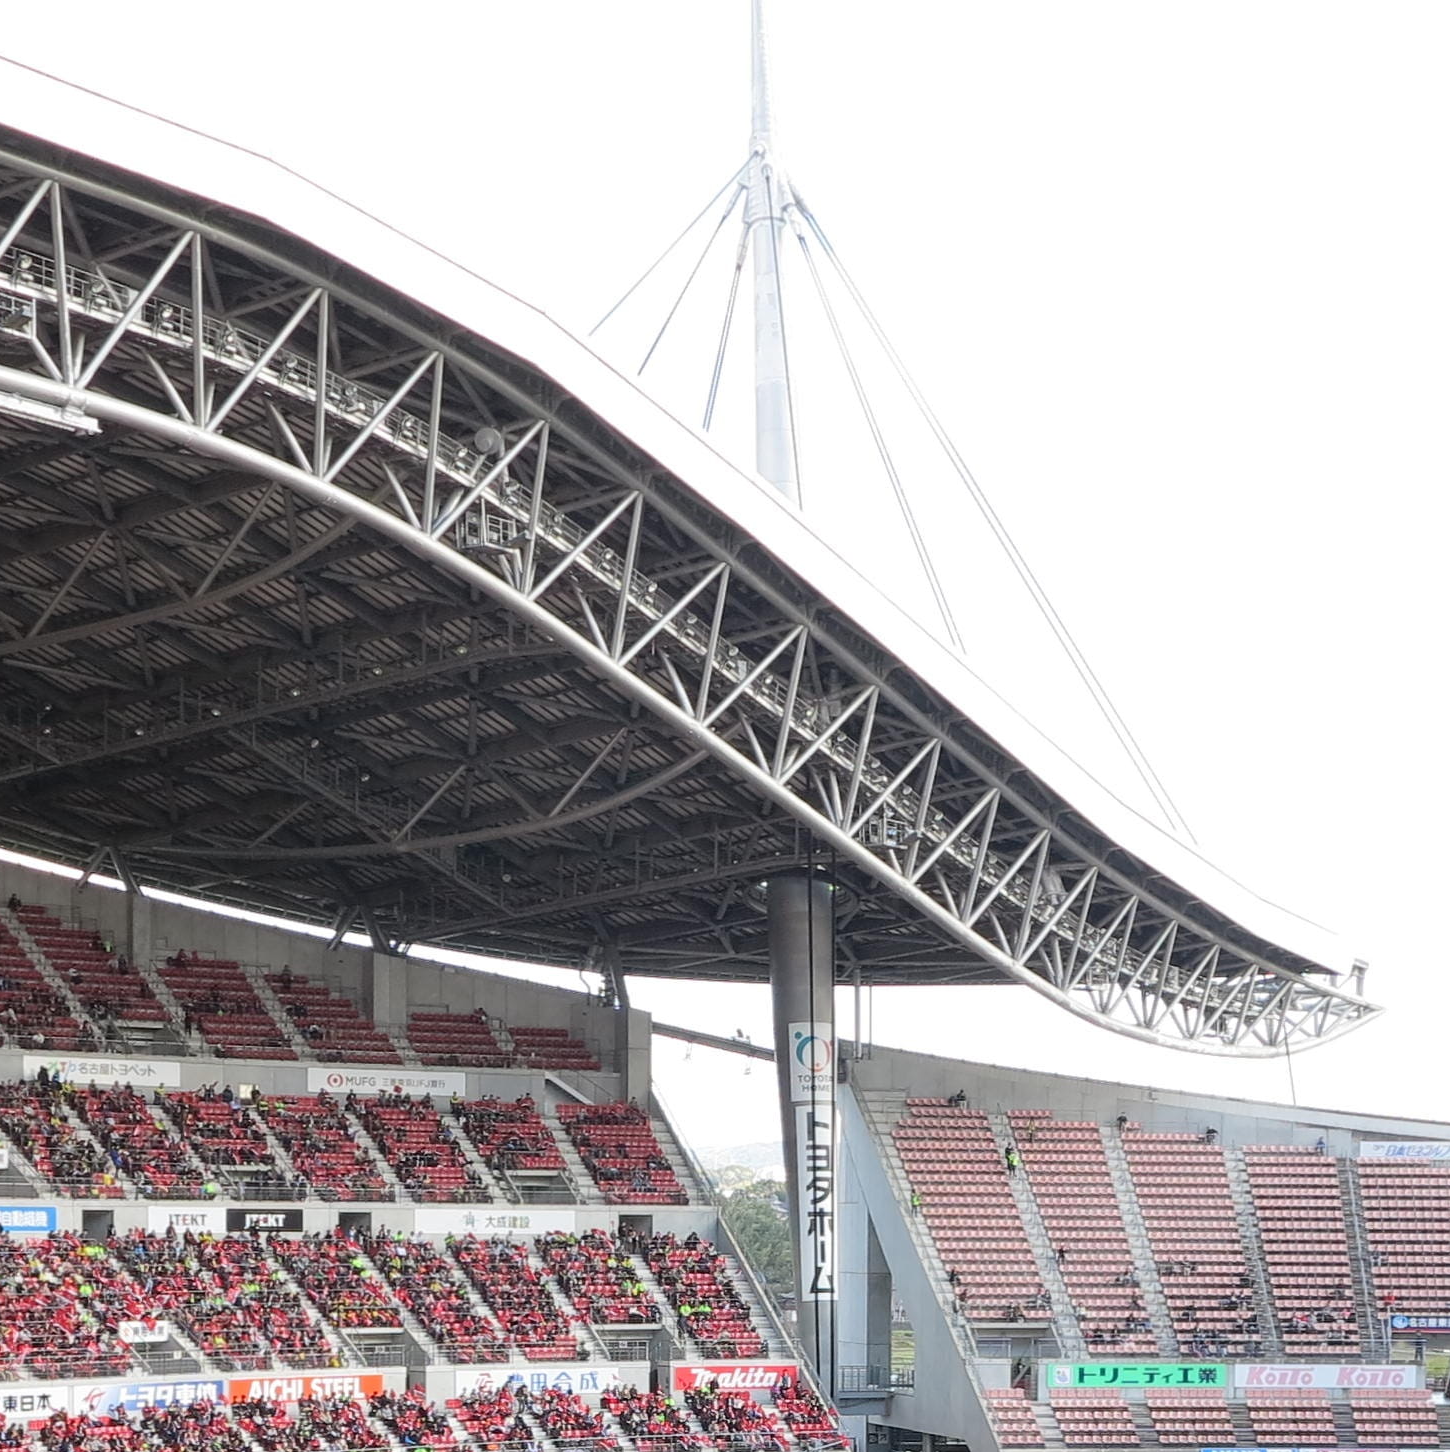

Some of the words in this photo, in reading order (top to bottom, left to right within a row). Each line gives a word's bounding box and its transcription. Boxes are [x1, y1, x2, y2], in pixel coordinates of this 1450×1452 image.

[77, 1062, 157, 1078] 名古屋トヨペット
[345, 1076, 377, 1088] MUFG
[169, 1213, 207, 1229] JTEKT
[485, 1215, 531, 1229] 大成建設
[508, 1371, 601, 1394] 豊田合成
[1077, 1367, 1216, 1384] トリニティ工業
[248, 1379, 304, 1401] AICHI
[309, 1378, 366, 1400] STEEL
